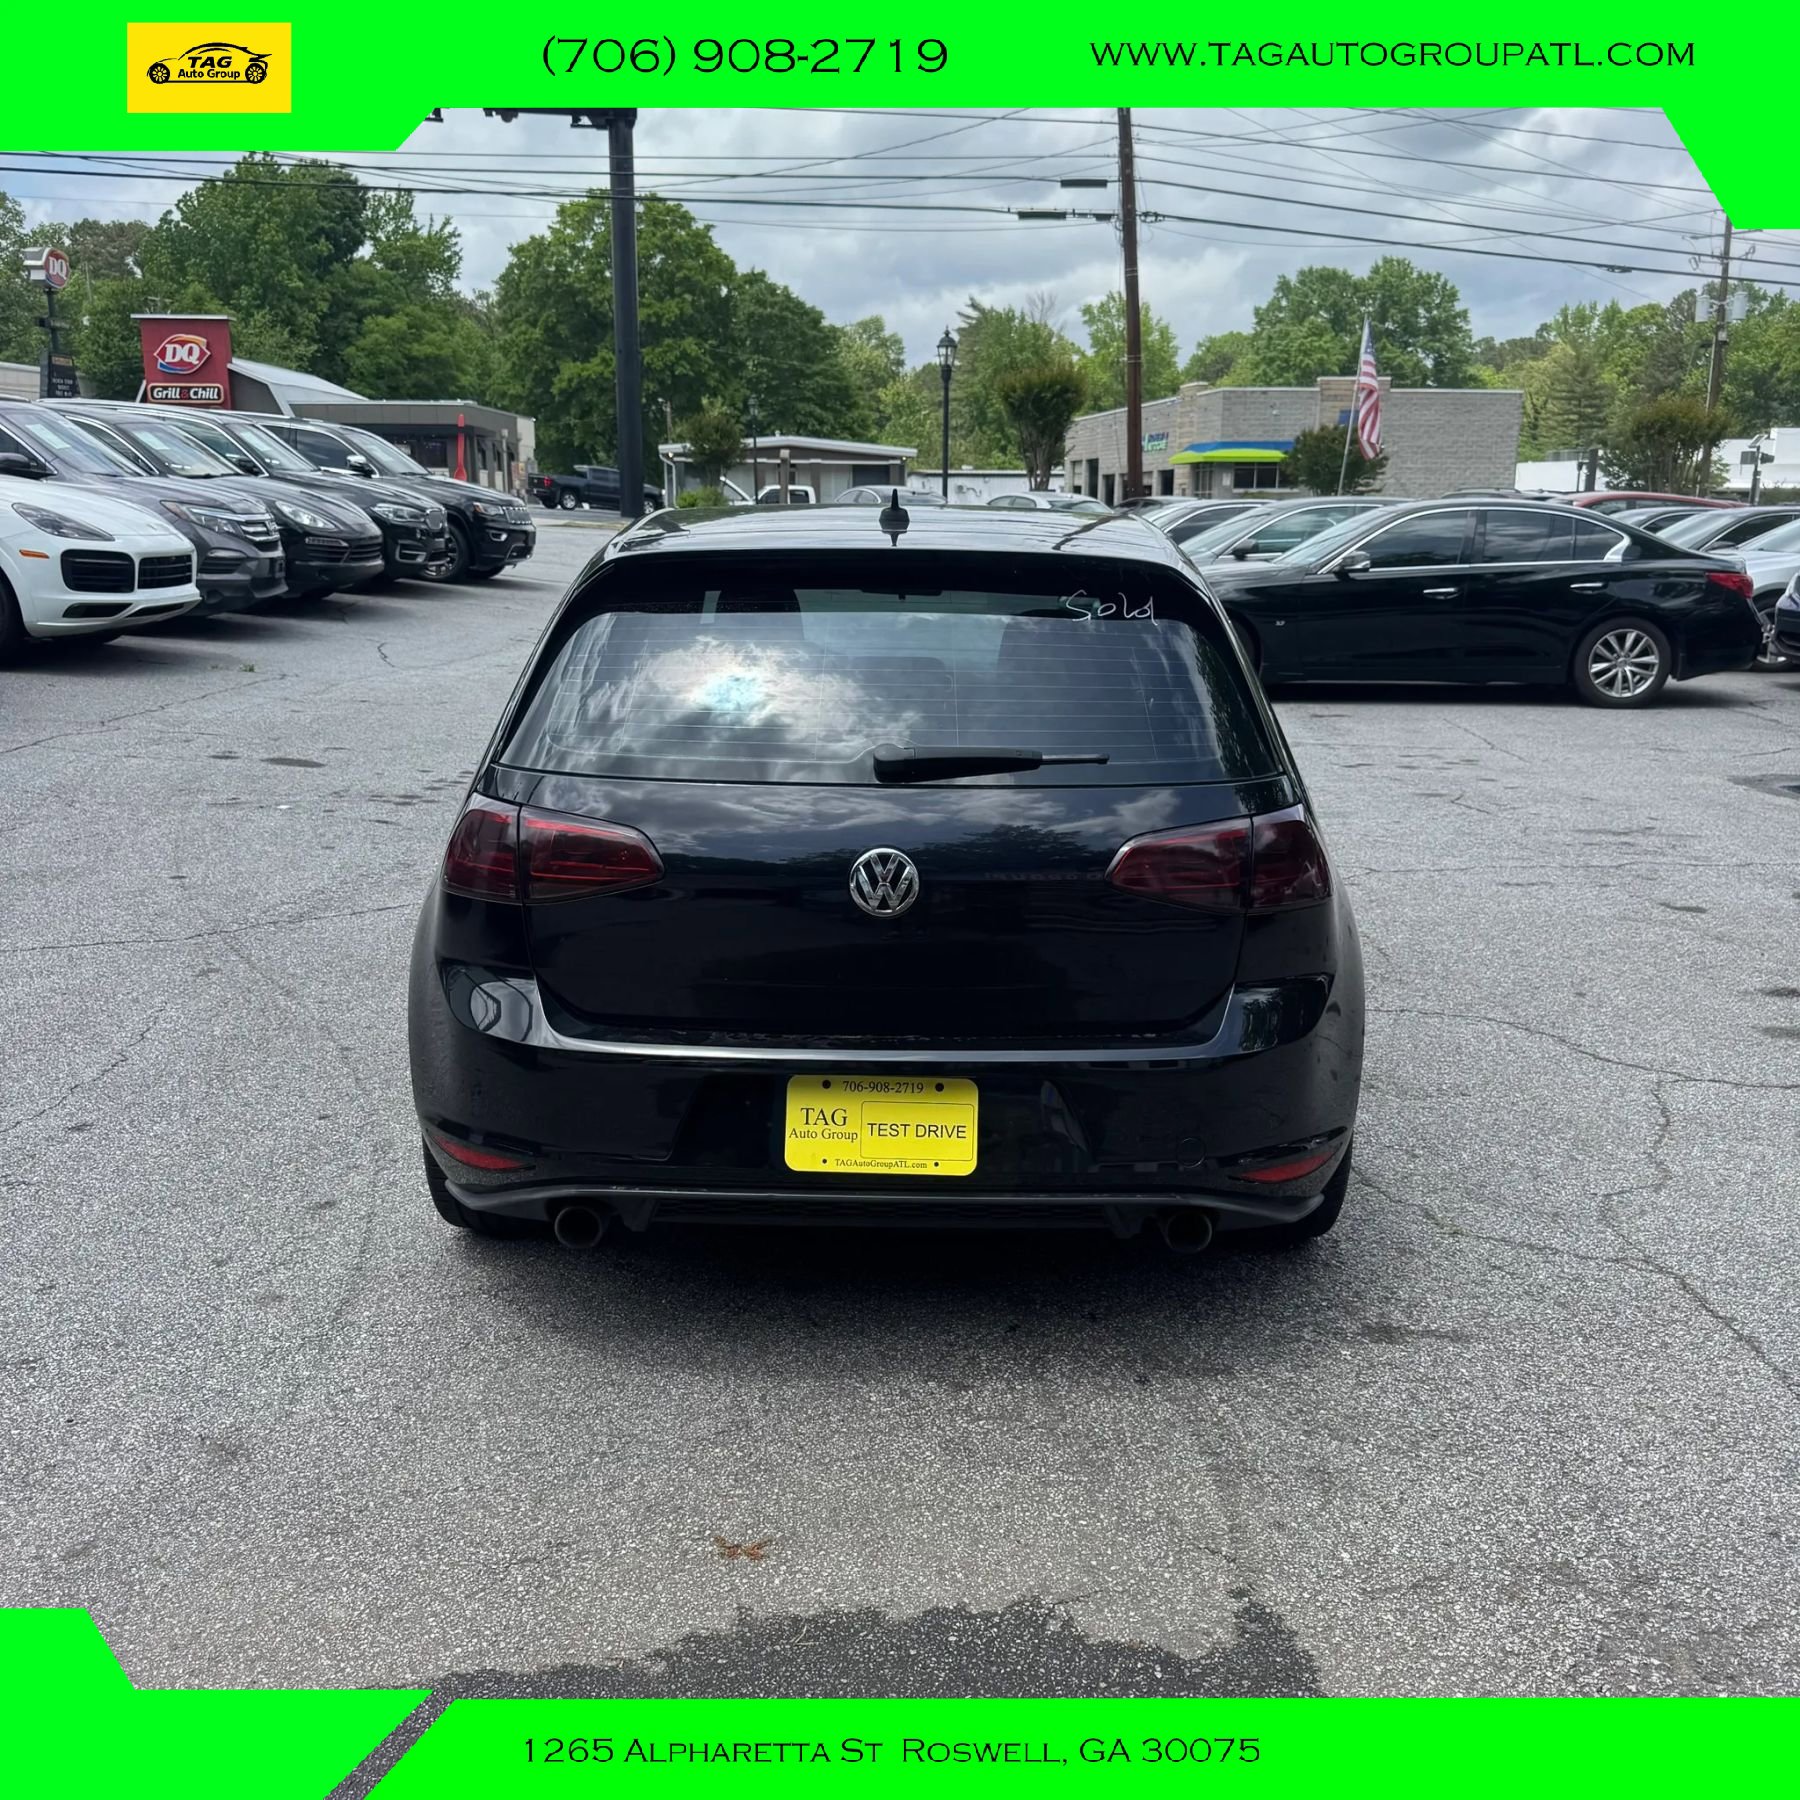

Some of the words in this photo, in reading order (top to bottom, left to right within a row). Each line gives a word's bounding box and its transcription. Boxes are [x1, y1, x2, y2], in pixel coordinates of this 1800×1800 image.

[49, 257, 68, 281] DQ
[164, 343, 200, 365] DQ
[153, 387, 180, 399] Grill
[189, 387, 219, 399] Chill
[1066, 589, 1158, 626] Sold
[842, 1080, 924, 1094] 706-908-2719
[800, 1107, 848, 1127] TAG
[788, 1128, 818, 1139] Auto
[821, 1129, 858, 1143] Group
[867, 1123, 910, 1137] TEST
[915, 1124, 967, 1139] DRIVE
[834, 1158, 928, 1170] TAGAutoGroupATL.com
